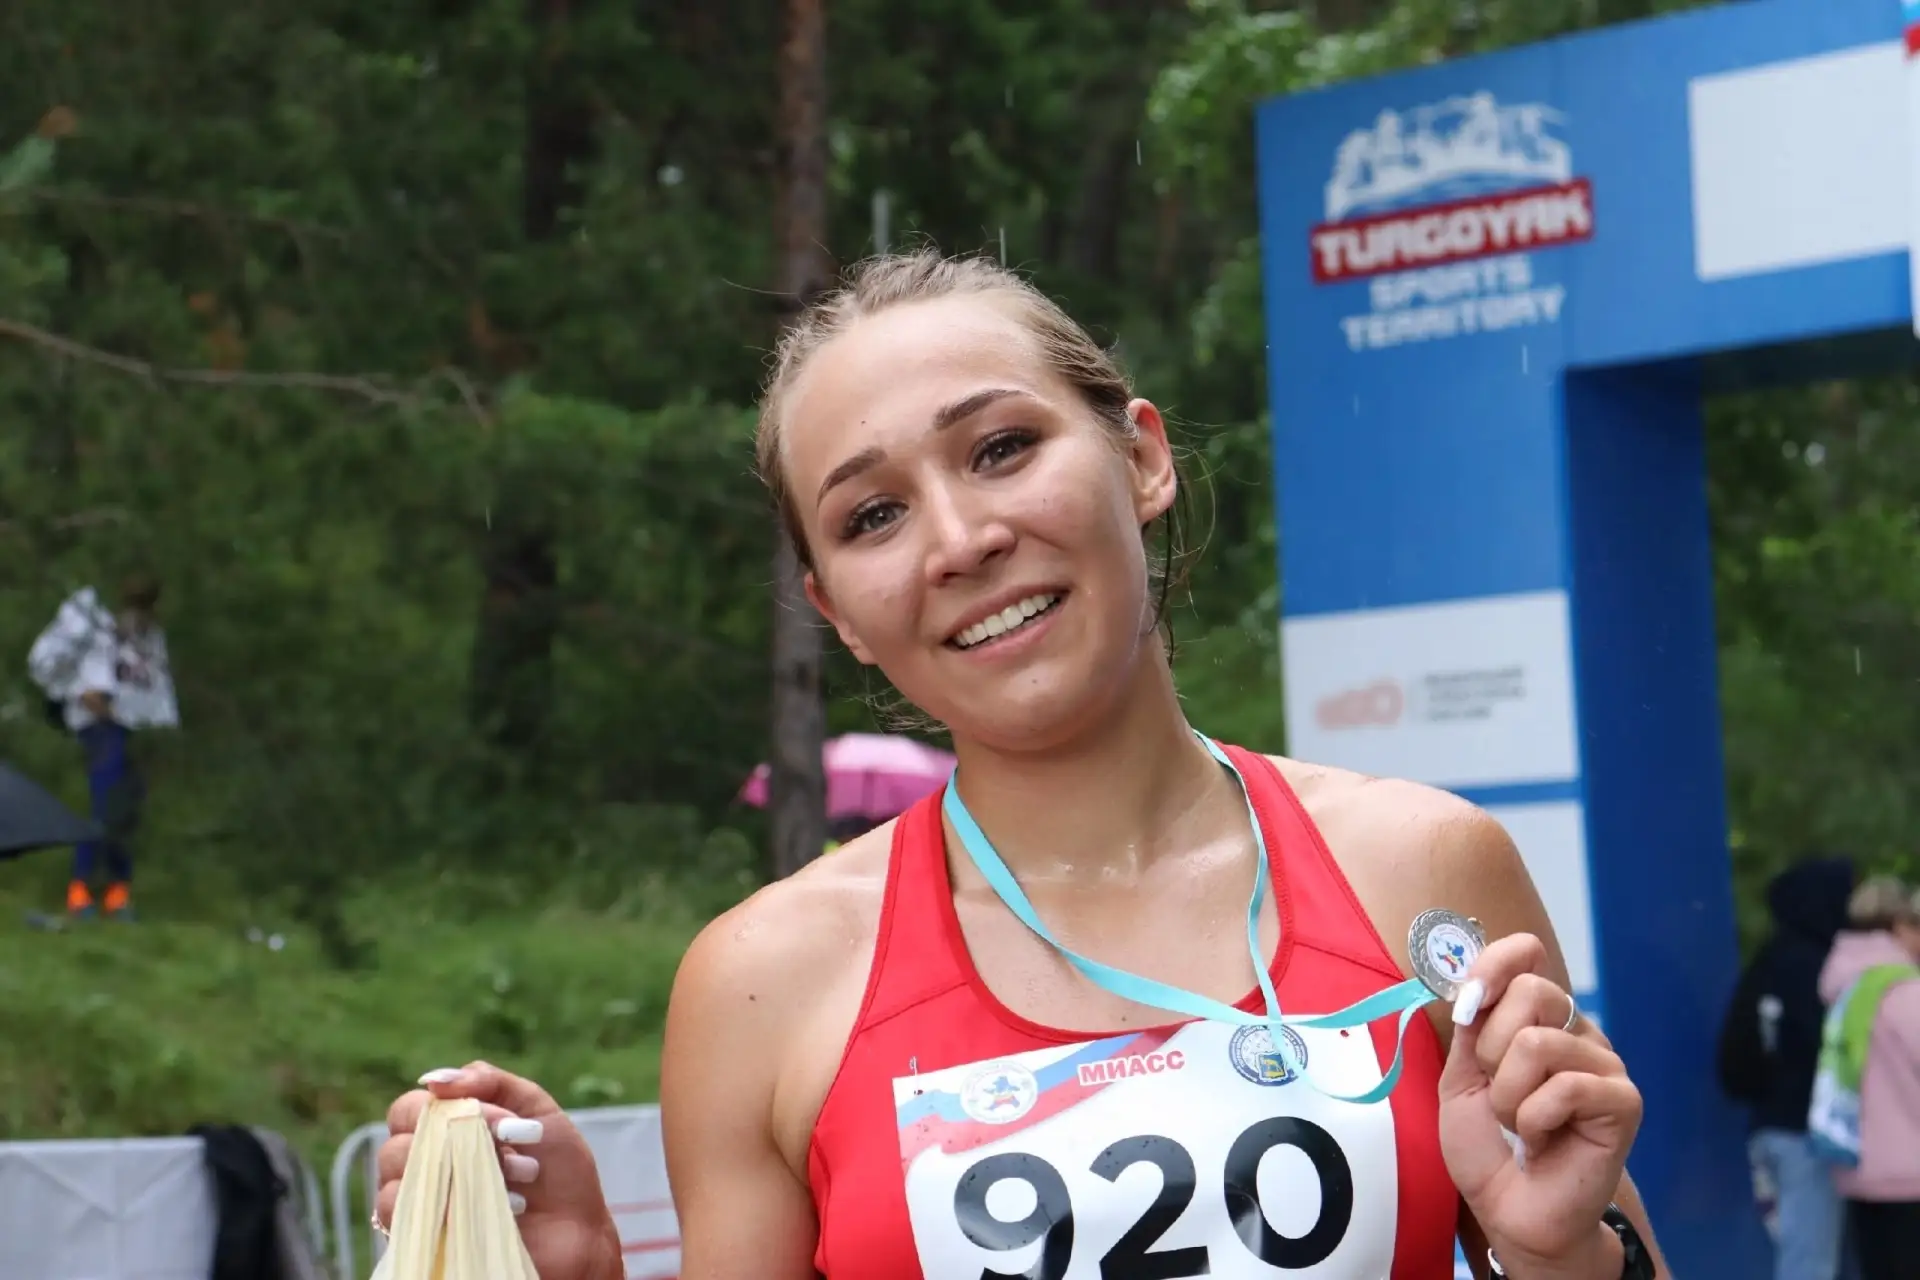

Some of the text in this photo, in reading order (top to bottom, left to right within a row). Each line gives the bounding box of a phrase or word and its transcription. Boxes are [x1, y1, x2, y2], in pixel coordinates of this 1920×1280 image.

[1314, 189, 1590, 275] TURGOYAK
[1371, 255, 1531, 310] SPORTS
[1342, 286, 1564, 350] TERRITORY
[1079, 1050, 1185, 1083] МИАСС
[953, 1116, 1354, 1280] 920
